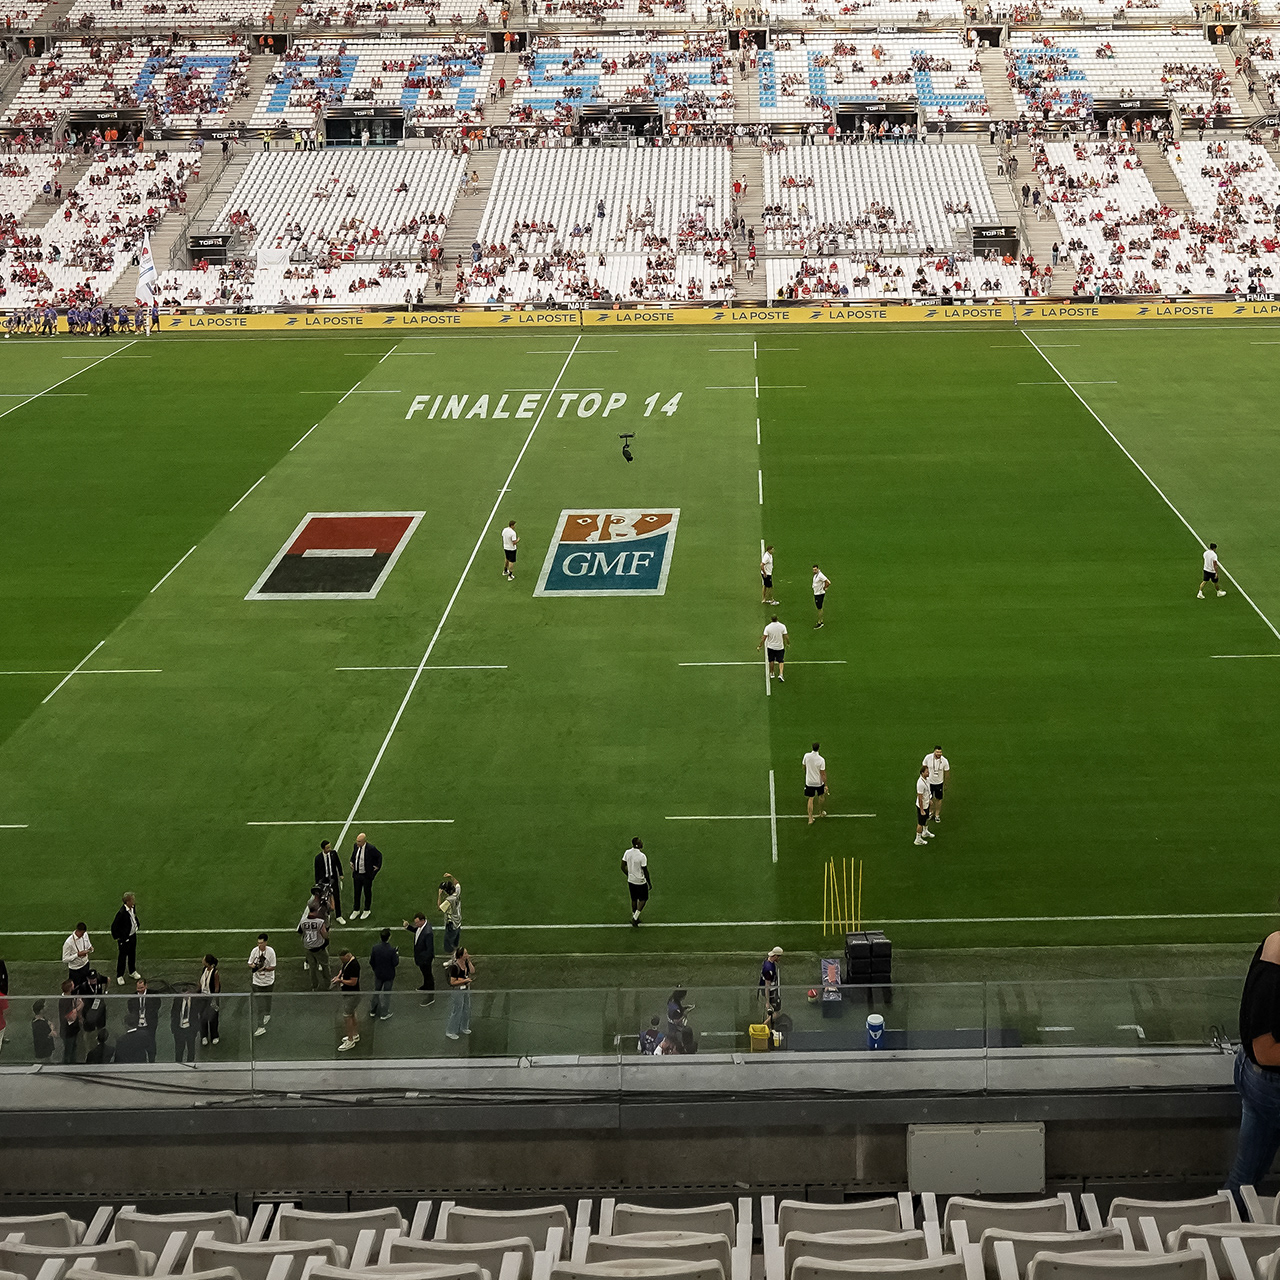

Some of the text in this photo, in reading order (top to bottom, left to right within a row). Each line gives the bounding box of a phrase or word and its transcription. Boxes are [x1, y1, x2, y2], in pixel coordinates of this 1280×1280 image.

[1246, 294, 1274, 302] FINALE
[944, 308, 1002, 318] LA POSTE
[1042, 308, 1098, 317] LA POSTE
[1156, 306, 1214, 316] LA POSTE
[1253, 305, 1268, 314] LA
[403, 315, 460, 324] LA POSTE
[520, 314, 576, 323] LA POSTE
[616, 312, 674, 322] LA POSTE
[732, 312, 790, 321] LA POSTE
[830, 310, 886, 320] LA POSTE
[190, 318, 248, 327] LA POSTE
[306, 316, 363, 326] LA POSTE
[405, 392, 683, 420] FINALE TOP 14
[562, 551, 654, 576] GMF
